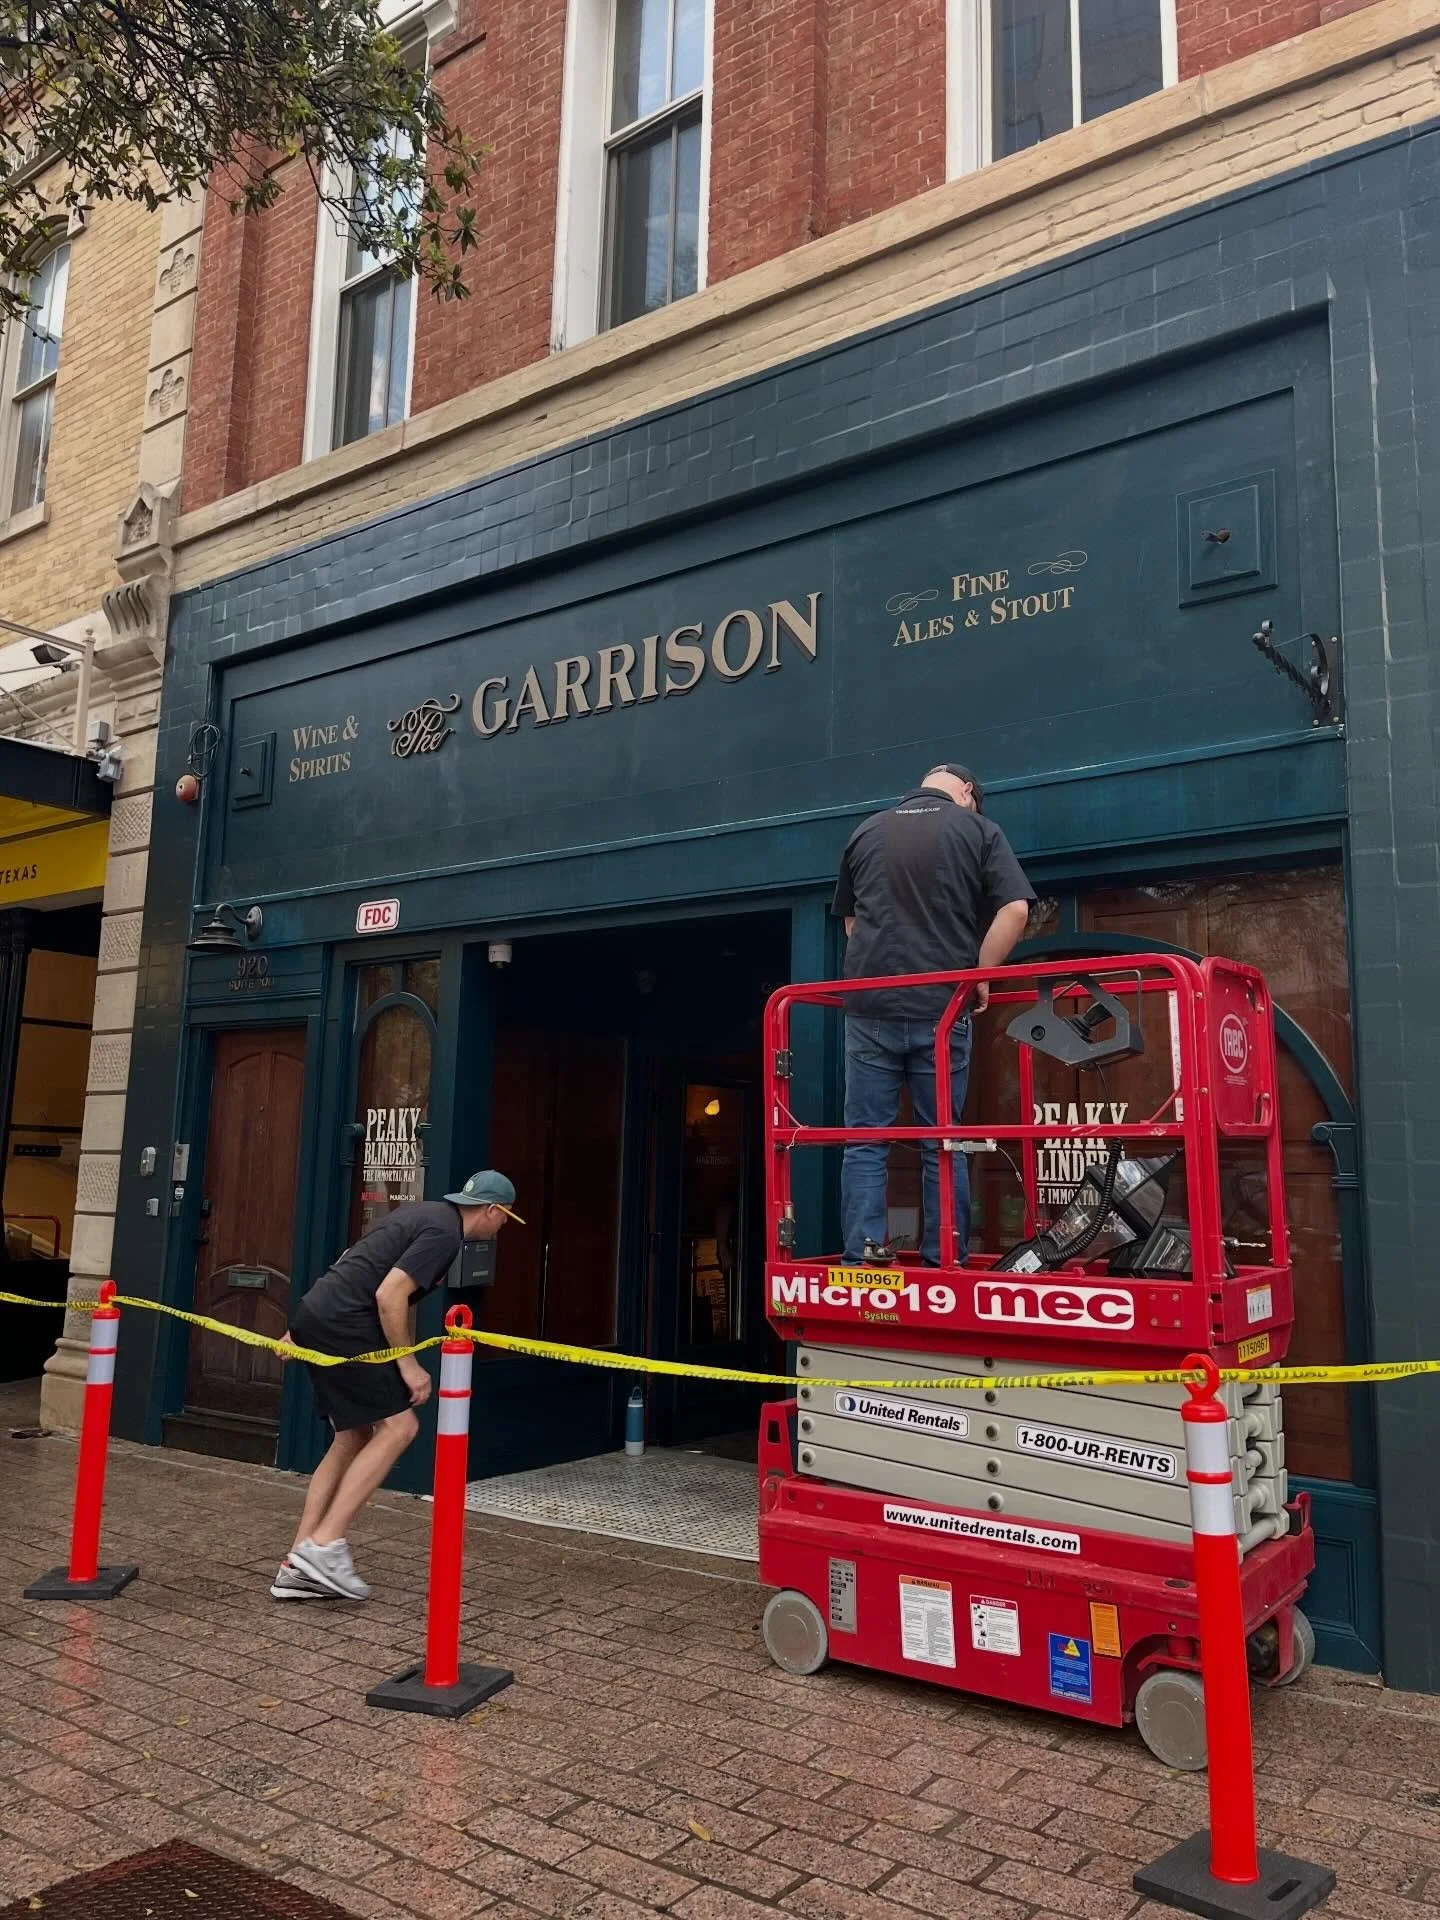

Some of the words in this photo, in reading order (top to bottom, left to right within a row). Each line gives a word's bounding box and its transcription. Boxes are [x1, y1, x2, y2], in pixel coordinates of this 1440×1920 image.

[952, 569, 1010, 601] FINE
[893, 615, 954, 647] ALES
[964, 609, 979, 627] &
[990, 586, 1075, 626] STOUT
[387, 693, 461, 758] The
[472, 592, 822, 738] GARRISON
[292, 725, 338, 752] WINE
[342, 715, 359, 741] &
[289, 752, 351, 782] SPIRITS
[364, 906, 391, 926] FDC
[365, 1108, 421, 1141] PEAKY
[364, 1142, 417, 1165] BLINDERS
[363, 1169, 374, 1181] THE
[772, 1276, 957, 1314] Micro19
[830, 1271, 901, 1286] 11150967
[864, 1311, 898, 1321] System
[977, 1286, 1133, 1324] mec
[1239, 1338, 1268, 1358] 11150967
[858, 1399, 905, 1421] United
[907, 1411, 961, 1432] Rentals
[1020, 1430, 1171, 1473] 1-800-UR-RENTS
[886, 1510, 1078, 1551] www.unitedrentals.com
